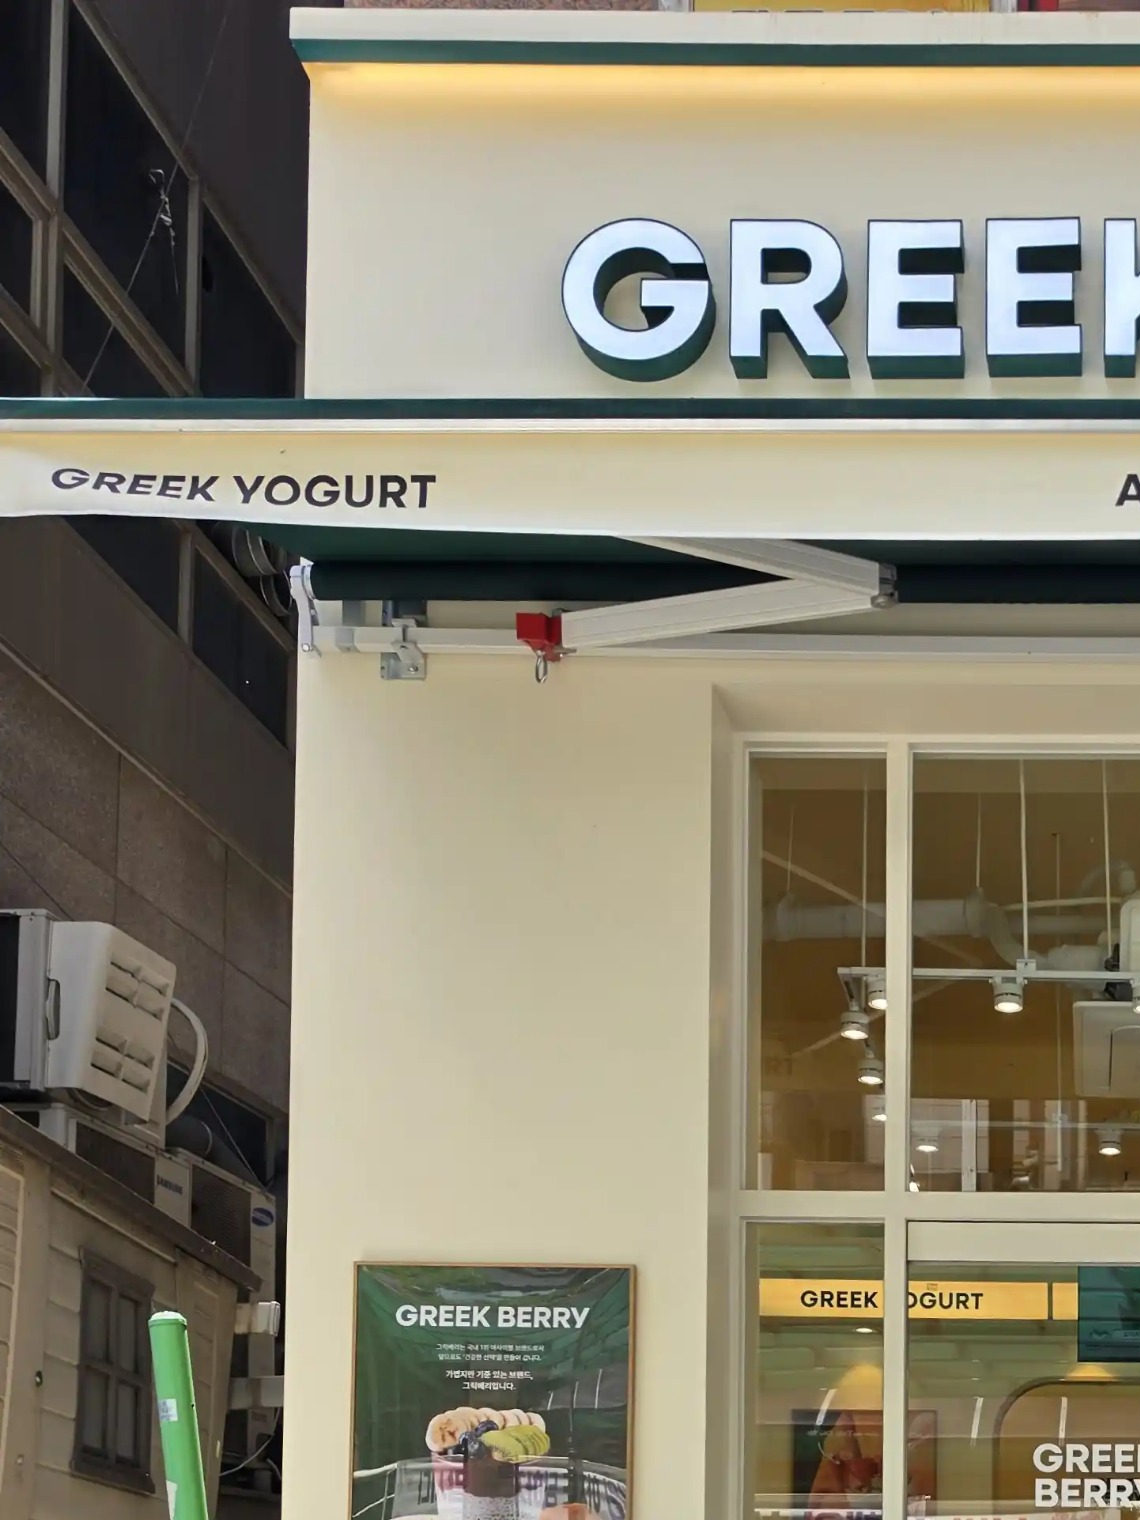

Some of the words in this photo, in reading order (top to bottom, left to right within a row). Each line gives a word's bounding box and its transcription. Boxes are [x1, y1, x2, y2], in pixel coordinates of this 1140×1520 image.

[51, 467, 220, 502] GREEK
[232, 474, 437, 509] YOGURT
[800, 1290, 879, 1309] GREEK
[907, 1291, 984, 1310] OGURT
[395, 1304, 491, 1328] GREEK
[497, 1306, 591, 1328] BERRY
